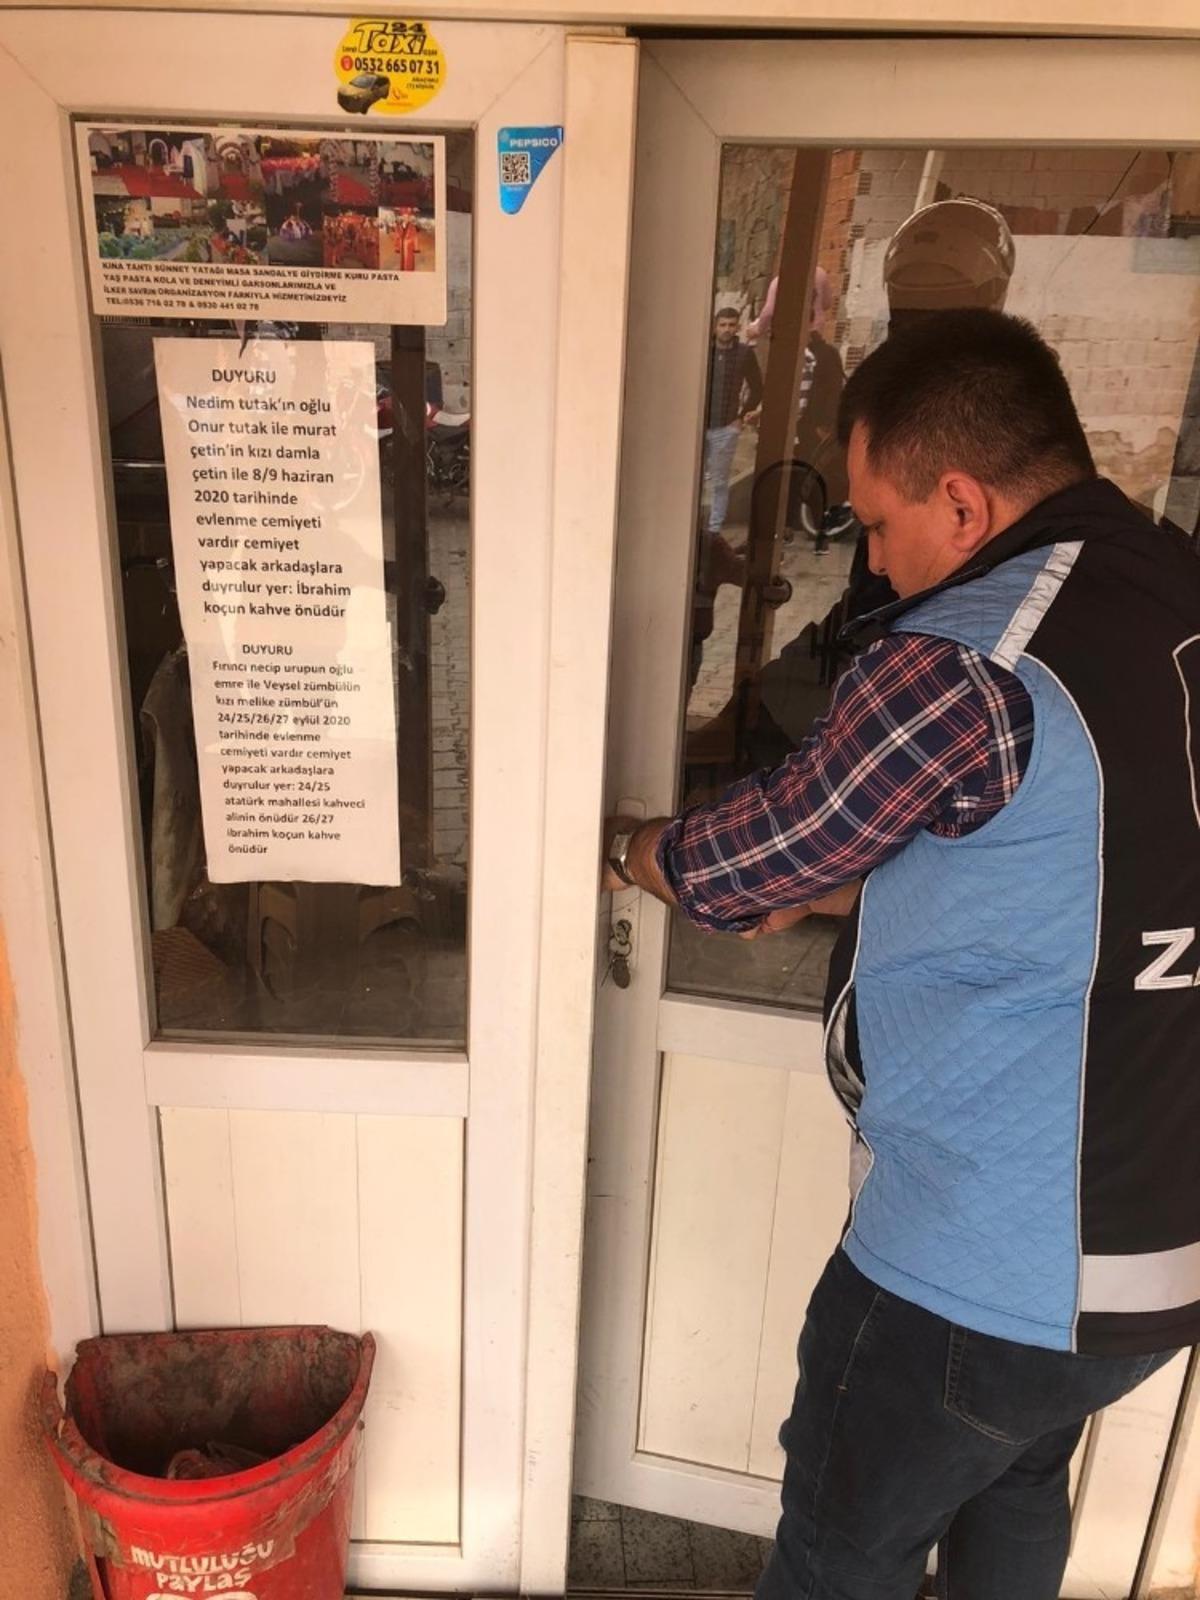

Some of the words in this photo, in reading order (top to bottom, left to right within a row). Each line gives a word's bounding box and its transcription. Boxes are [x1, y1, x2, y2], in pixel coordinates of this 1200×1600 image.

[353, 21, 426, 54] Taxi
[355, 57, 384, 72] 0532
[386, 58, 408, 73] 665
[409, 60, 424, 74] 07
[426, 61, 440, 75] 31
[510, 138, 558, 148] PEPSICO
[126, 263, 152, 272] TAHTI
[155, 264, 189, 273] SÜNNET
[192, 266, 224, 274] YATAĞI
[227, 267, 250, 276] MASA
[253, 268, 298, 278] SANDALYE
[300, 270, 342, 279] GİYDİRME
[345, 273, 368, 281] KURU
[372, 274, 399, 282] PASTA
[104, 274, 120, 283] YAŞ
[123, 275, 152, 284] PASTA
[154, 276, 176, 285] KOLA
[180, 278, 191, 286] VE
[193, 278, 239, 287] DENEYİMLİ
[242, 280, 322, 290] GARSONLARIMIZLA
[158, 286, 226, 298] ORGANİZASYON
[228, 291, 270, 299] FARKIYLA
[272, 292, 346, 302] HİZMETİNİZDEYİZ
[164, 300, 174, 308] 02
[236, 302, 247, 310] 02
[212, 368, 276, 384] DUYURU
[186, 396, 235, 410] Nedim
[300, 399, 330, 414] oğlu
[188, 420, 224, 433] Onur
[228, 420, 268, 434] tutak
[272, 422, 288, 436] ile
[293, 424, 336, 437] murat
[248, 445, 272, 458] kızı
[276, 446, 320, 460] damla
[192, 467, 227, 482] çetin
[232, 468, 248, 481] ile
[252, 468, 278, 484] 8/9
[282, 469, 334, 483] haziran
[194, 490, 229, 504] 2020
[233, 492, 298, 505] tarihinde
[196, 513, 257, 527] evlenme
[261, 515, 321, 531] cemiyeti
[198, 536, 239, 548] vardır
[244, 537, 300, 553] cemiyet
[200, 558, 257, 573] yapacak
[261, 560, 343, 576] arkadaşlara
[202, 580, 261, 595] duyrulur
[265, 585, 293, 596] yer:
[204, 601, 245, 616] koçun
[250, 603, 290, 616] kahve
[295, 604, 346, 617] önüdür
[242, 644, 293, 656] DUYURU
[212, 661, 248, 672] Fırıncı
[250, 663, 281, 674] necip
[284, 664, 326, 675] urupun
[214, 680, 244, 689] emre
[246, 679, 261, 690] ile
[263, 680, 301, 692] Veysel
[303, 681, 360, 692] zümbülün
[216, 695, 235, 706] kızı
[237, 696, 275, 707] melike
[218, 713, 289, 725] 24/25/26/27
[292, 715, 320, 726] eylül
[323, 716, 350, 726] 2020
[219, 730, 270, 741] tarihinde
[273, 731, 321, 742] evlenme
[220, 747, 268, 759] cemiyeti
[271, 748, 304, 759] vardır
[306, 749, 351, 761] cemiyet
[222, 764, 267, 775] yapacak
[270, 765, 334, 777] arkadaşlara
[223, 780, 270, 791] duyrulur
[273, 783, 295, 793] yer:
[298, 782, 330, 793] 24/25
[225, 797, 265, 807] atatürk
[268, 798, 321, 808] mahallesi
[323, 799, 365, 809] kahveci
[226, 813, 256, 822] alinin
[259, 814, 299, 823] önüdür
[302, 814, 334, 824] 26/27
[272, 830, 305, 841] koçun
[308, 830, 341, 841] kahve
[228, 844, 268, 854] önüdür
